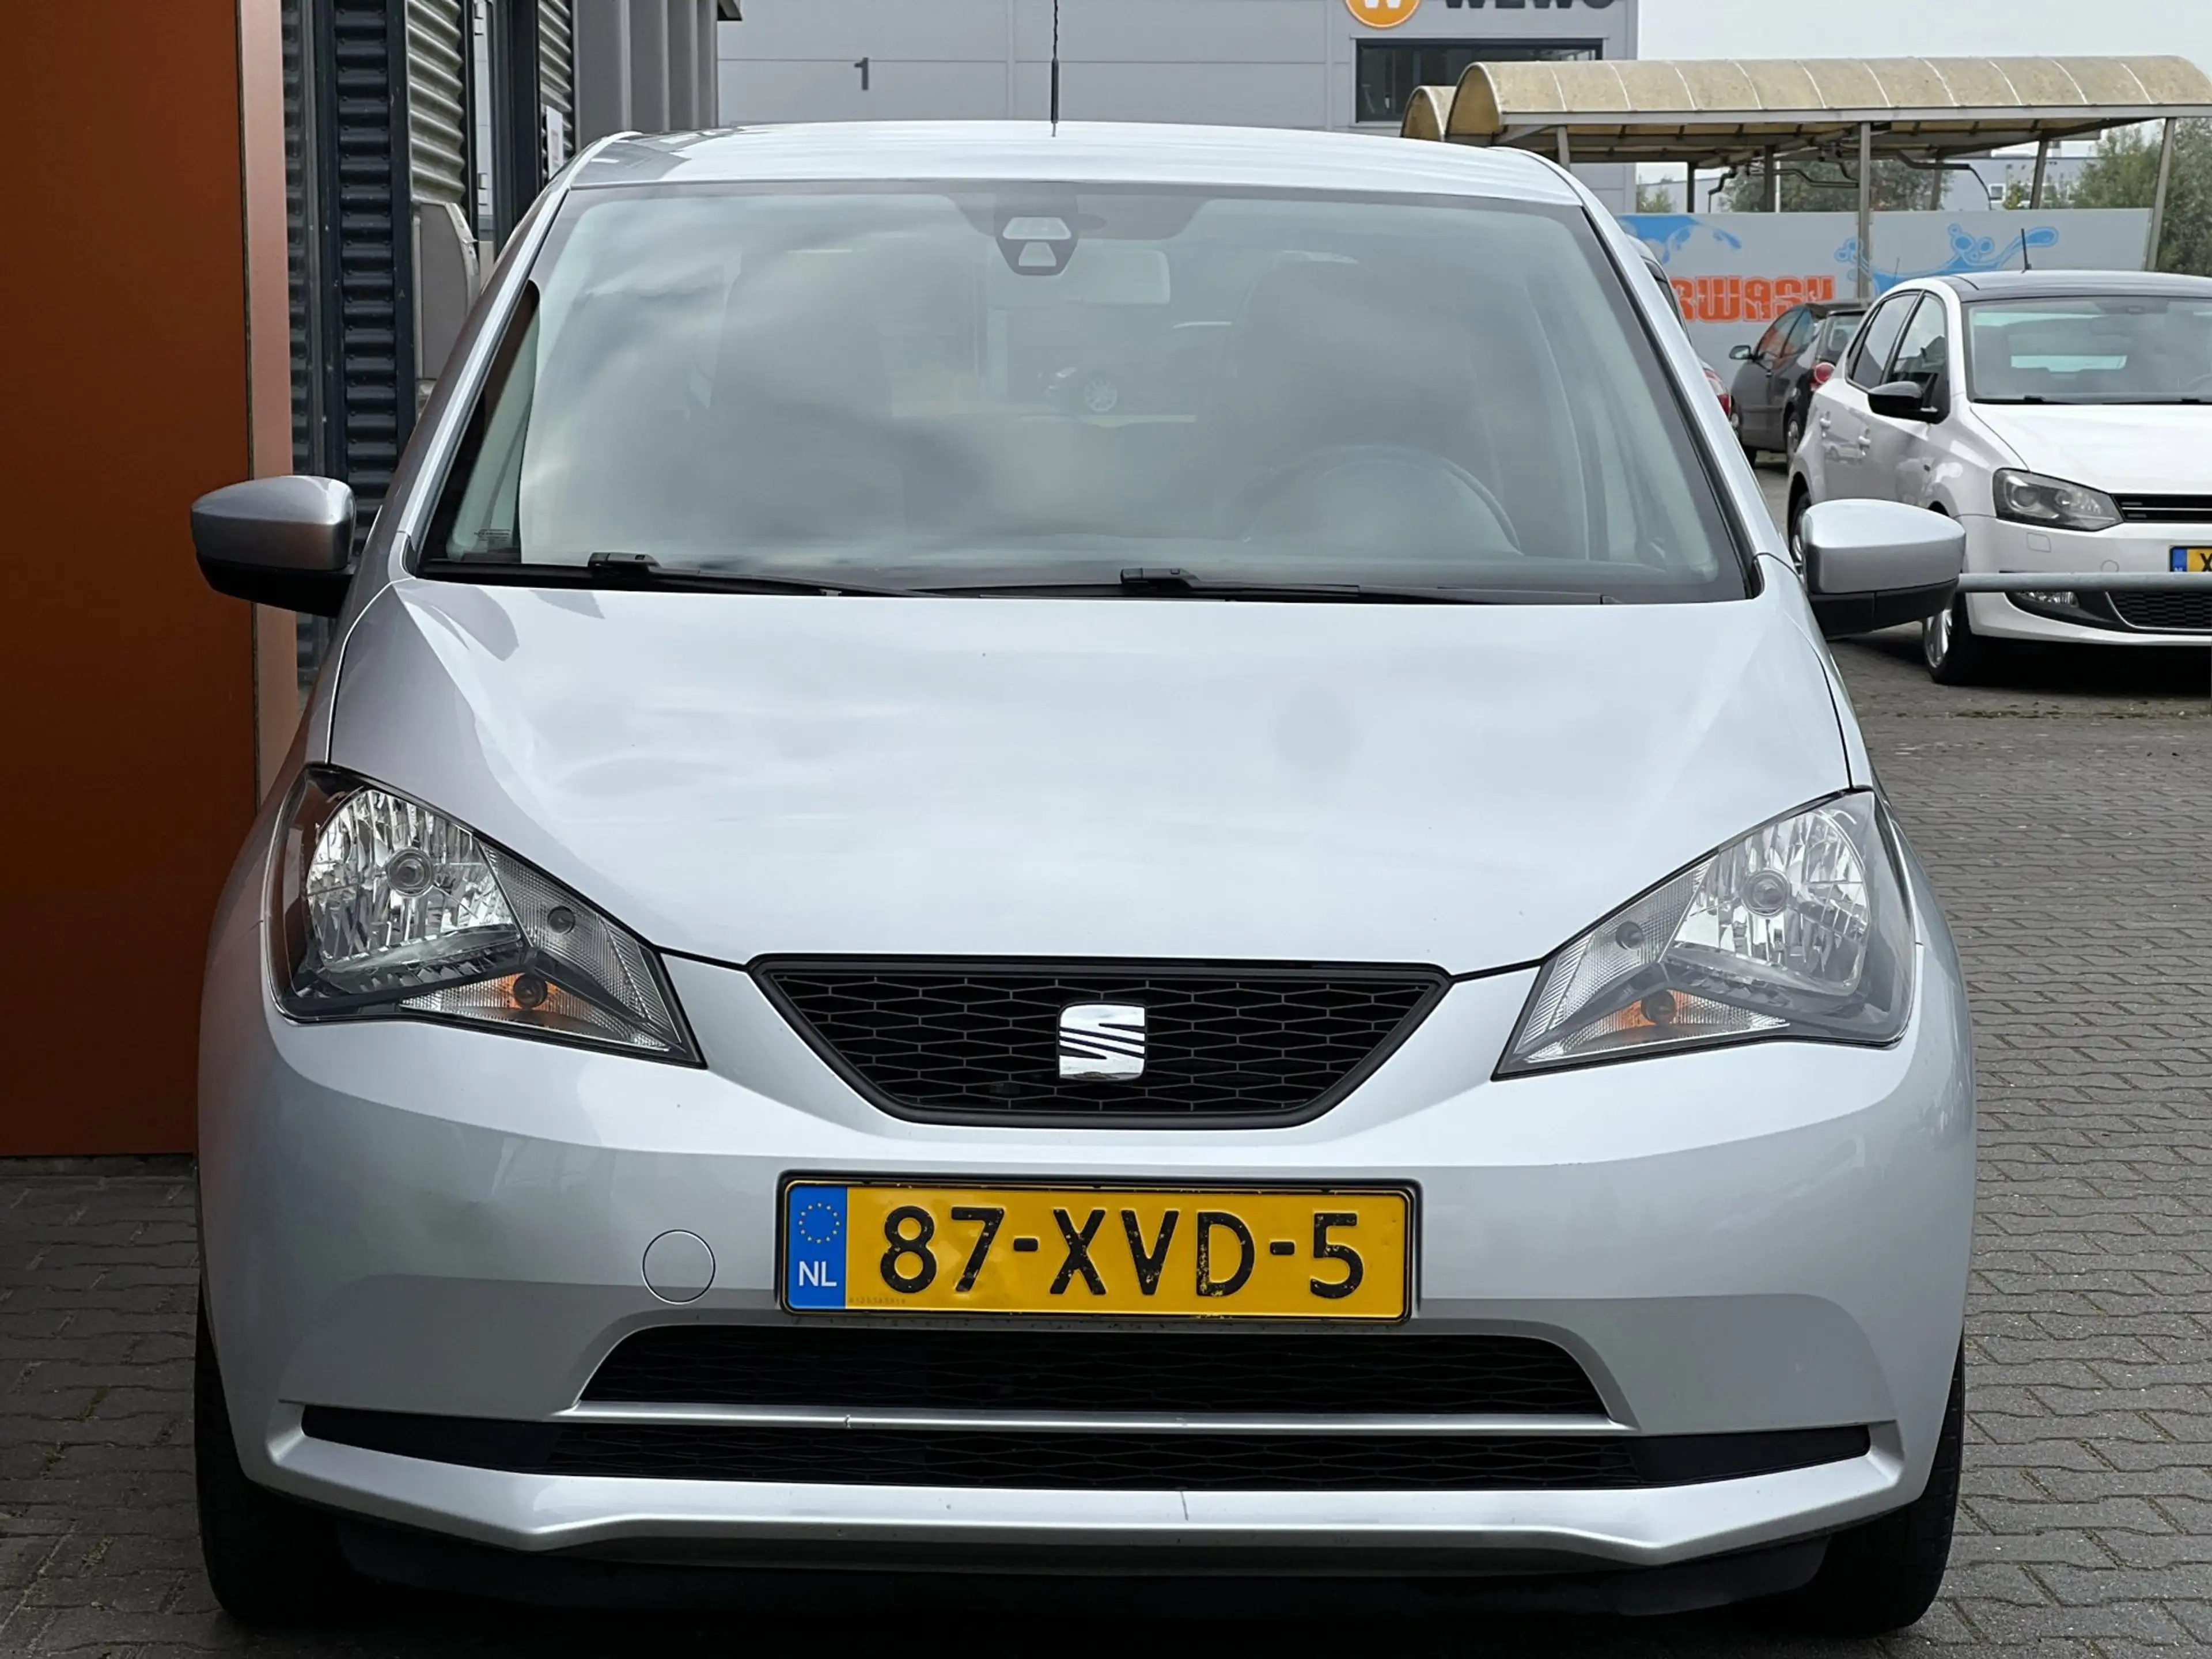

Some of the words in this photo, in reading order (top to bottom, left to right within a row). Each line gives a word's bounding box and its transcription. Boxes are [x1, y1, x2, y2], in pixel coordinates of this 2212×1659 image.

[854, 57, 869, 91] 1
[880, 1206, 1364, 1298] 87-XVD-5
[798, 1260, 837, 1287] NL
